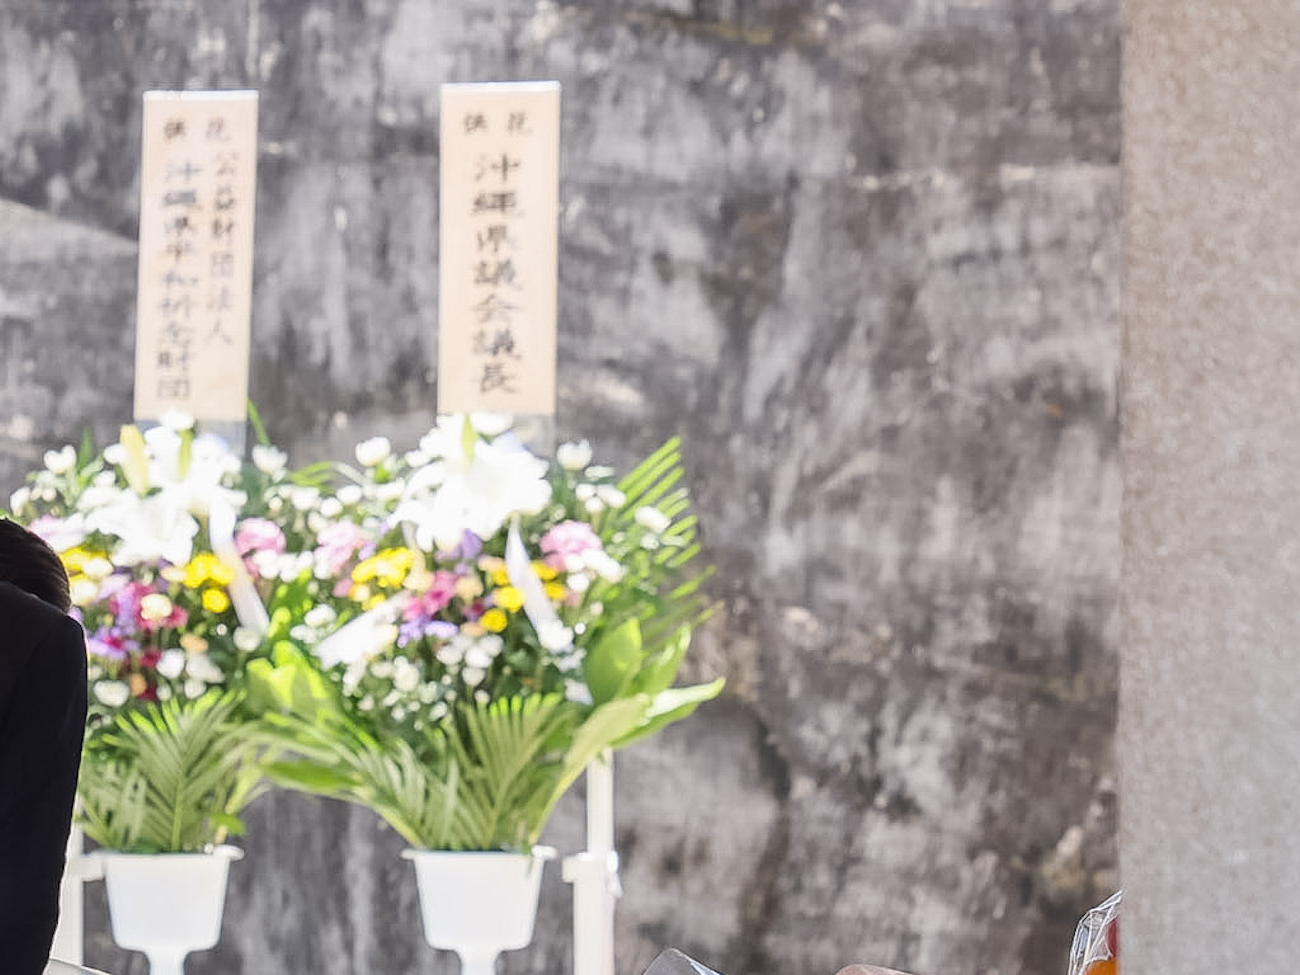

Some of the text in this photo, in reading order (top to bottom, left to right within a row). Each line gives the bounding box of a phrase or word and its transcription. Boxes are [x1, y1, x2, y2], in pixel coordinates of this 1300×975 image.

[470, 153, 524, 394] 沖縄県議会議長
